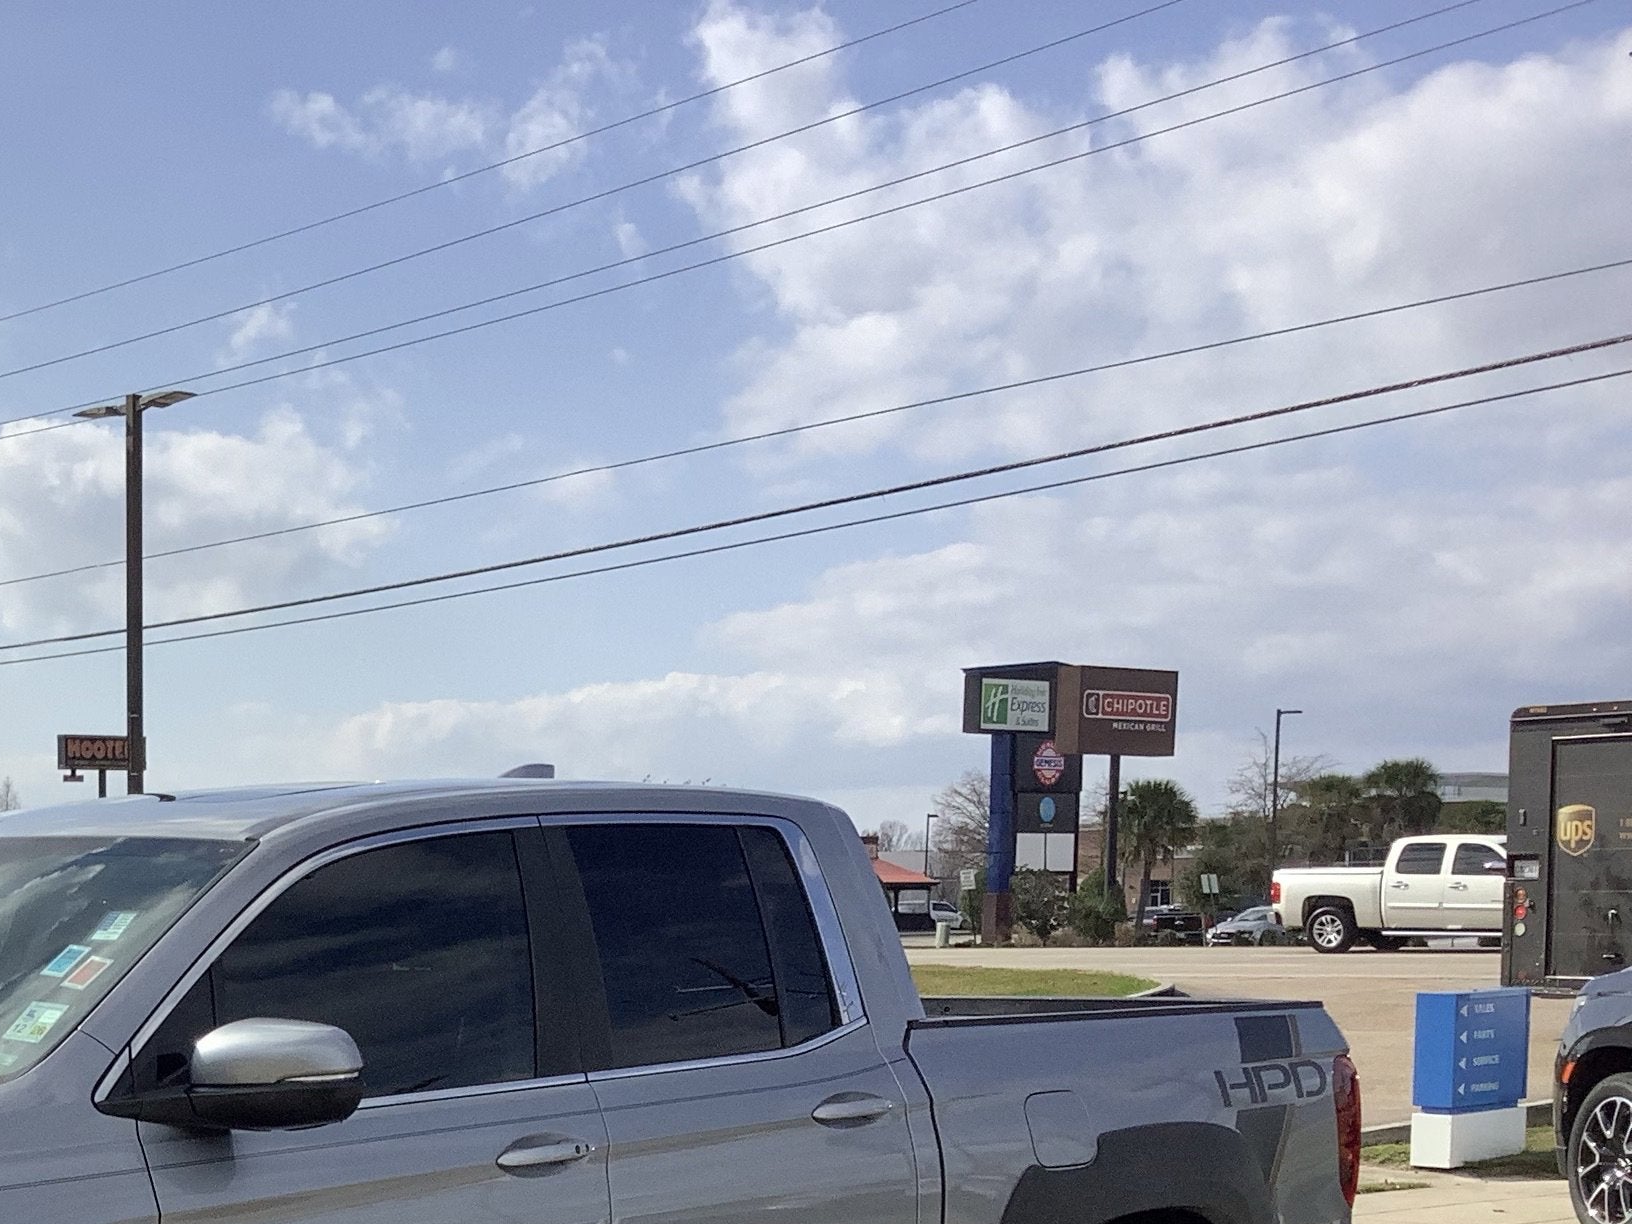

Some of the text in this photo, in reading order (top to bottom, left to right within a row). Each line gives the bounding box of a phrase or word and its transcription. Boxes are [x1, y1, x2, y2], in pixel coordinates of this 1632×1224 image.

[1011, 696, 1047, 714] Express
[1104, 698, 1168, 714] CHIPOTLE
[1112, 722, 1167, 732] MEXICAN GRILL
[1561, 820, 1593, 848] ups
[1214, 1059, 1327, 1108] HPD
